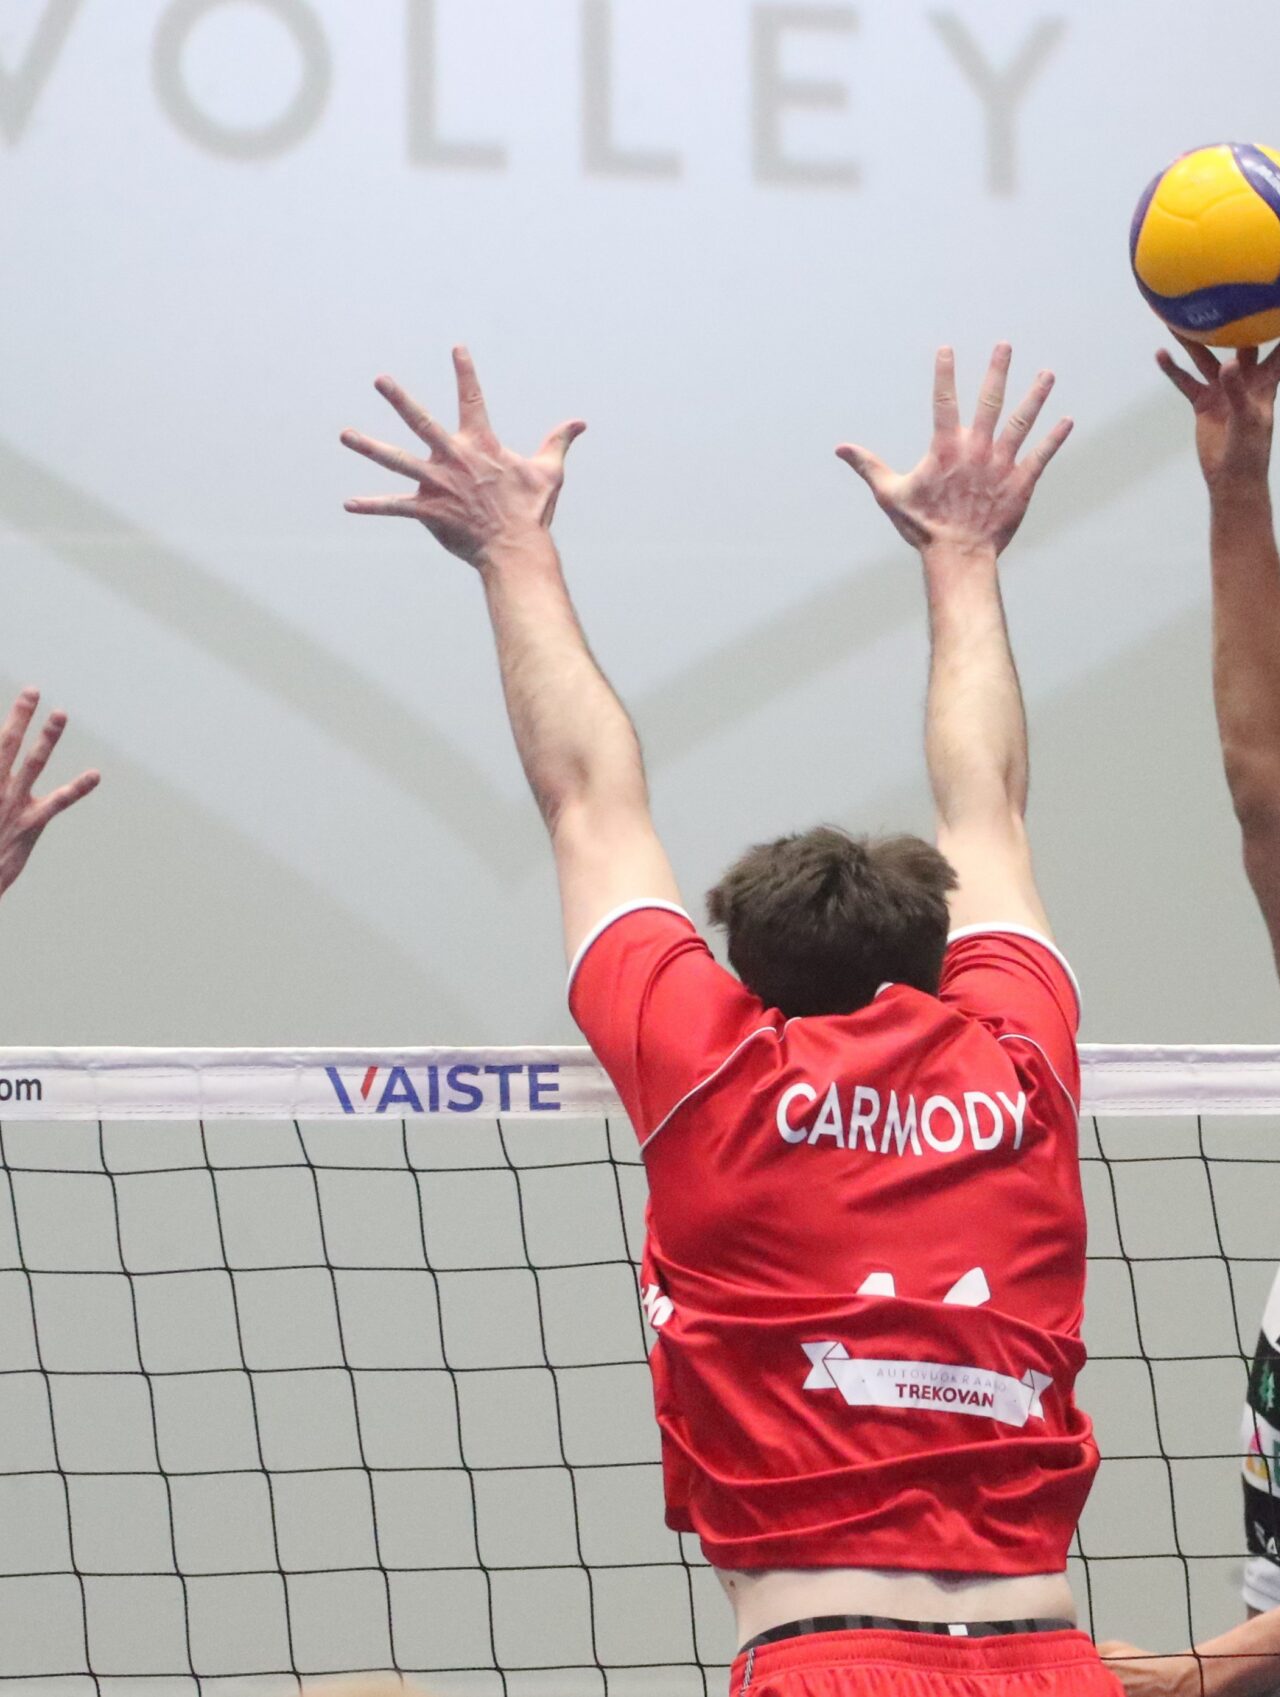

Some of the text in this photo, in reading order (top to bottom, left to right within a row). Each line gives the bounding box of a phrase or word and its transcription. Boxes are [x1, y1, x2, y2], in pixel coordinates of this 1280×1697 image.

[0, 0, 1068, 198] VOLLEY
[325, 1064, 562, 1113] VAISTE
[776, 1082, 1028, 1157] CARMODY
[895, 1383, 995, 1408] TREKOVAN
